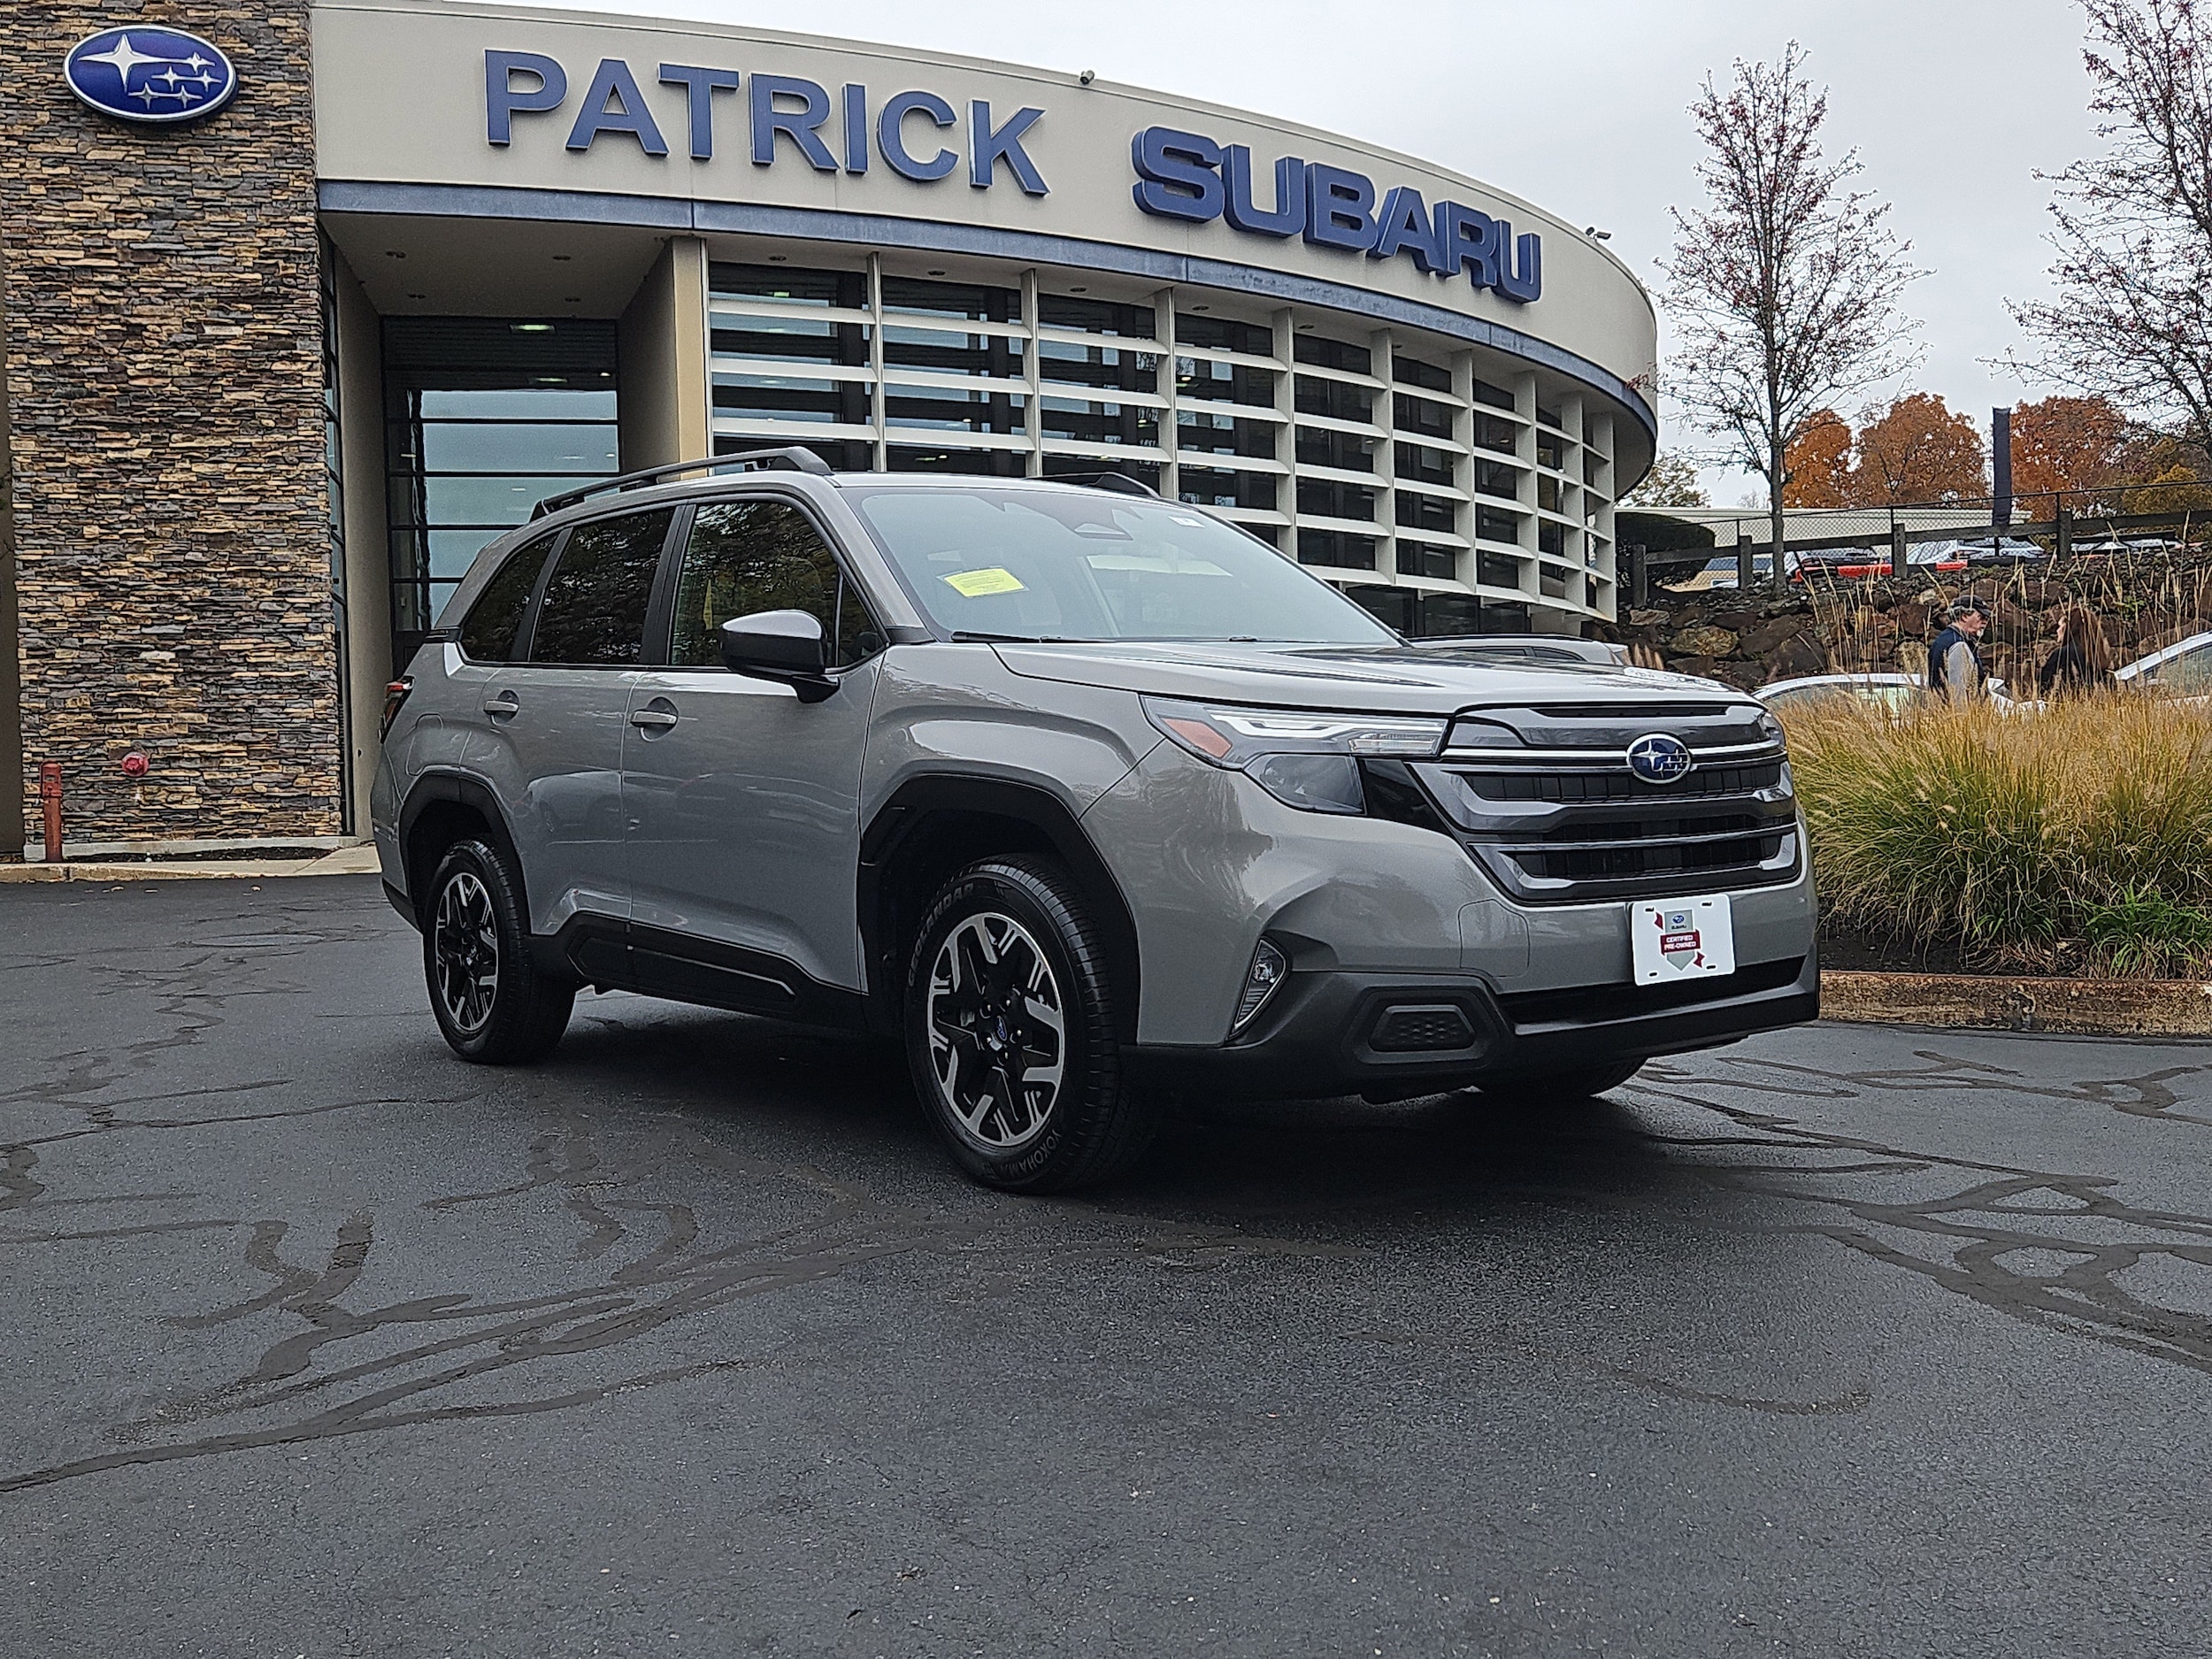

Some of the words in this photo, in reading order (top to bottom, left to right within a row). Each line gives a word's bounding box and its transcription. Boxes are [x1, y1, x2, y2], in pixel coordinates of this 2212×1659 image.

[483, 49, 1051, 196] PATRICK
[1132, 126, 1542, 304] SUBARU
[1664, 941, 1697, 950] PRE-OWNED
